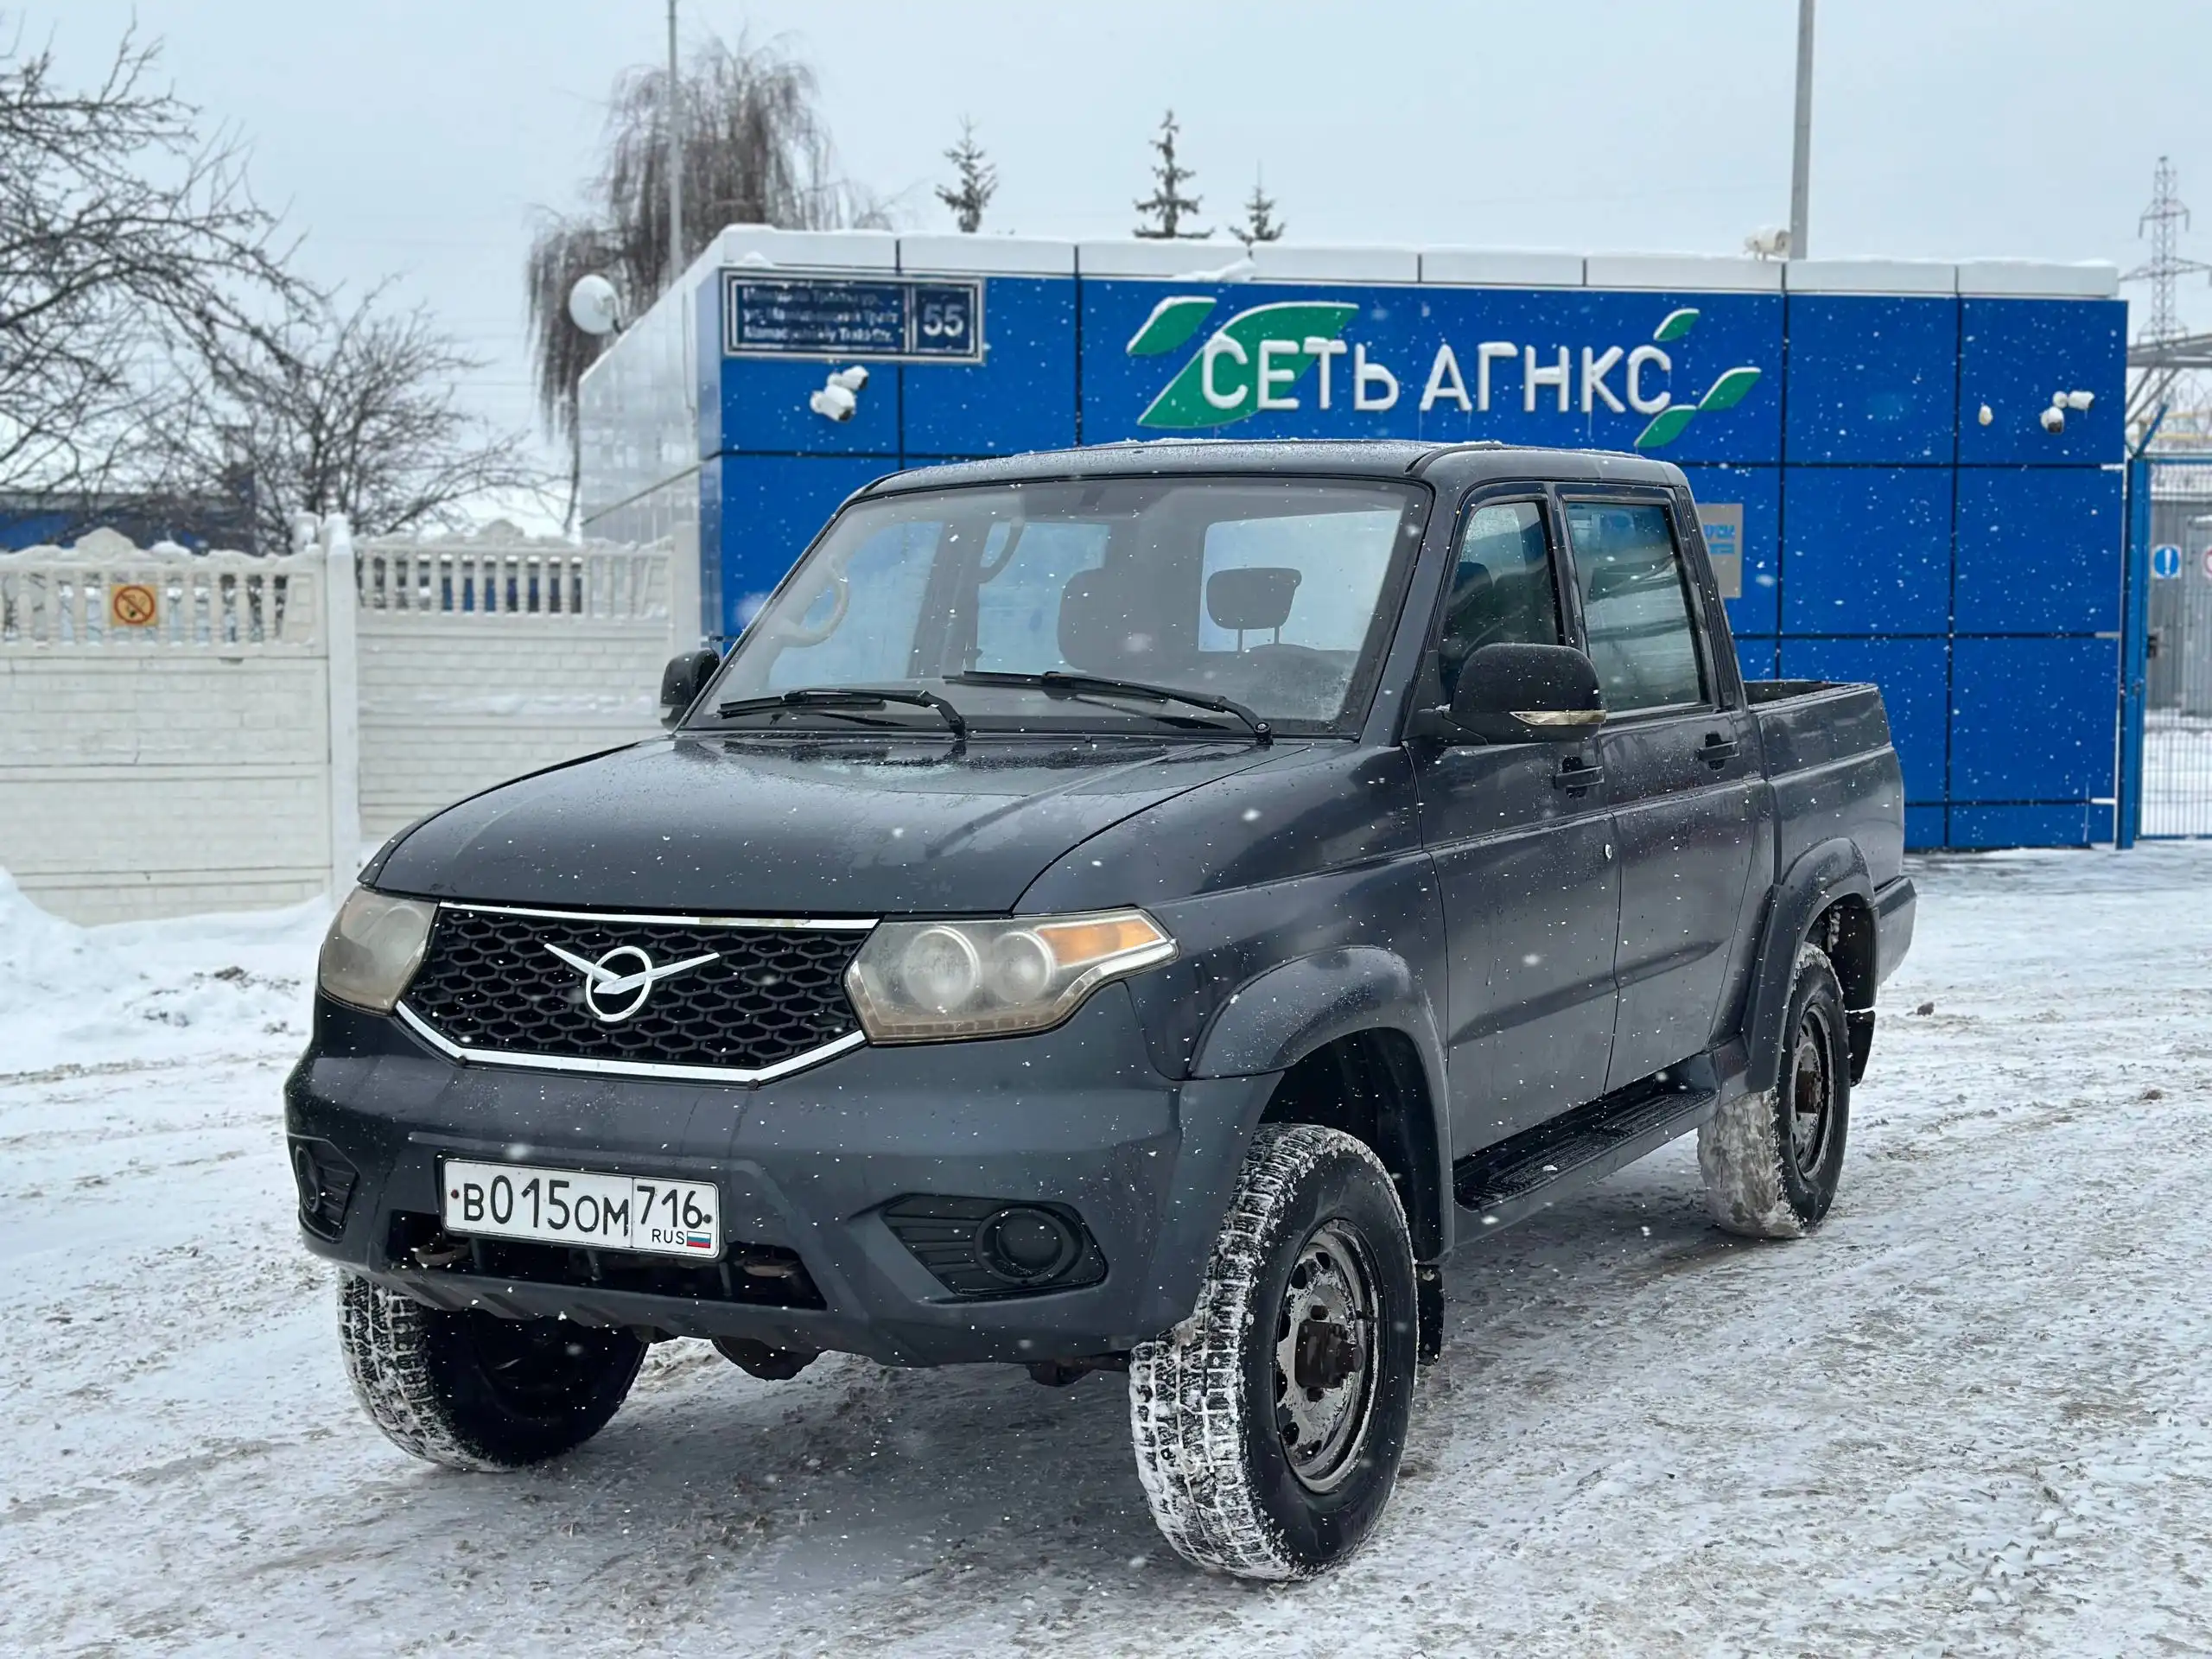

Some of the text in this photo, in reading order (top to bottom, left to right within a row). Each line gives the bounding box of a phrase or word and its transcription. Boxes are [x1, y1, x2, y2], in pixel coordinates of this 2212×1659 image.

[923, 302, 964, 336] 55
[1201, 334, 1672, 412] СЕТЬ АГНКС
[652, 1229, 685, 1245] RUS
